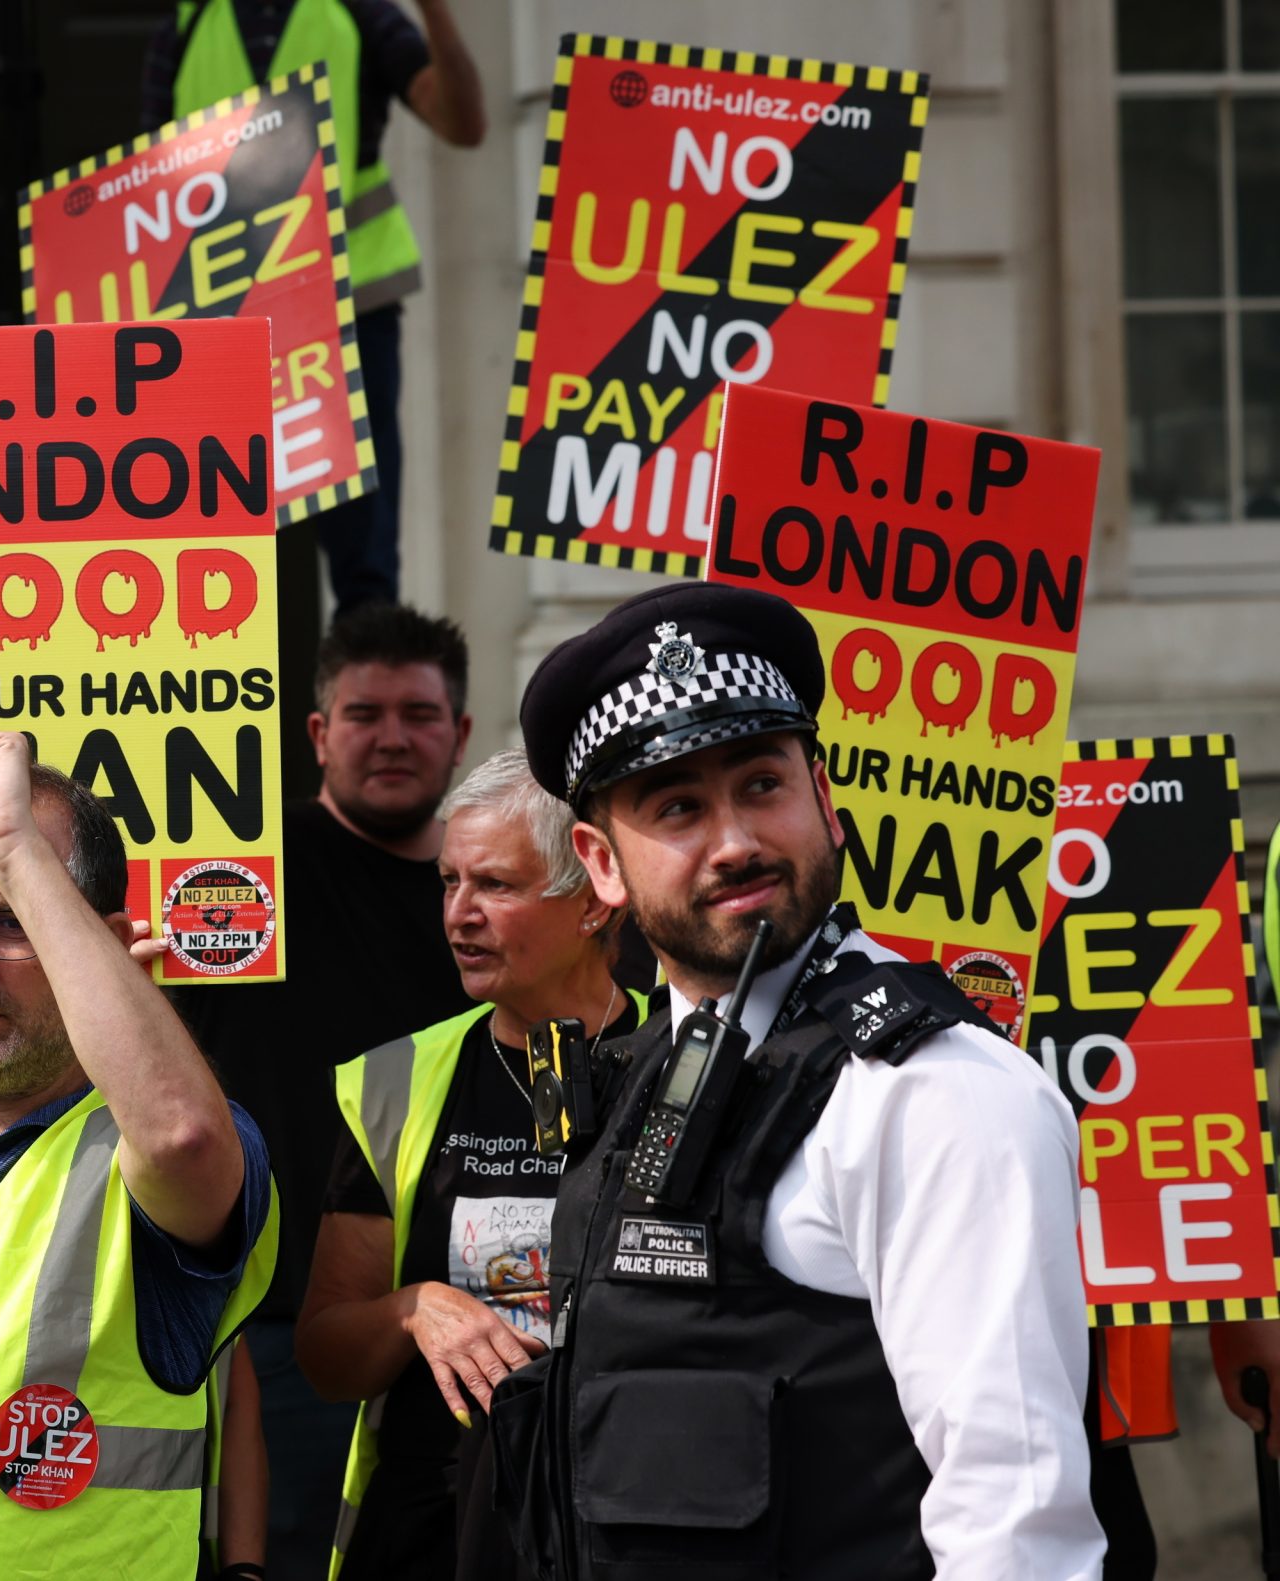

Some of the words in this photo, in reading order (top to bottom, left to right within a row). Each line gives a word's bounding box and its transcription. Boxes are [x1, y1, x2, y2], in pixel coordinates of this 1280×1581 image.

[650, 80, 872, 131] anti-ulez.com
[97, 109, 283, 203] anti-ulez.com
[669, 126, 794, 202] NO
[123, 171, 228, 255] NO
[571, 191, 881, 315] ULEZ
[647, 309, 774, 385] NO
[543, 371, 686, 444] PAY
[801, 401, 1029, 517] R.I.P
[546, 435, 717, 543] MIL
[713, 493, 1082, 634] LONDON
[81, 667, 275, 716] HANDS
[831, 628, 1057, 749] OOD
[816, 741, 890, 793] UR
[900, 754, 1056, 818] HANDS
[189, 862, 215, 877] STOP
[216, 861, 242, 873] ULEZ
[194, 878, 212, 886] GET
[214, 877, 240, 885] KHAN
[834, 807, 1043, 932] NAK
[1046, 827, 1112, 899] O
[184, 889, 202, 903] NO
[205, 889, 214, 902] 2
[217, 888, 253, 902] ULEZ
[165, 933, 195, 967] ACTION
[194, 963, 238, 975] AGAINST
[241, 946, 265, 968] ULEZ
[260, 928, 273, 946] EXT
[188, 934, 207, 948] NO
[210, 934, 220, 947] 2
[223, 933, 251, 947] PPM
[202, 949, 239, 963] OUT
[1030, 908, 1234, 1014] EZ
[851, 986, 888, 1021] AW
[956, 976, 970, 989] NO
[971, 978, 980, 991] 2
[981, 980, 1011, 995] ULEZ
[1040, 1032, 1137, 1105] O
[441, 1132, 527, 1156] ssington
[463, 1155, 515, 1176] Road
[1079, 1112, 1251, 1184] PER
[489, 1219, 539, 1233] KHAN
[491, 1204, 518, 1219] NO
[523, 1205, 545, 1218] TO
[644, 1225, 702, 1239] METROPOLITAN
[1079, 1181, 1243, 1287] LE
[613, 1254, 652, 1274] POLICE
[654, 1258, 708, 1278] OFFICER
[648, 1238, 694, 1253] POLICE
[8, 1400, 80, 1428] STOP
[4, 1462, 39, 1475] STOP
[41, 1465, 74, 1479] KHAN
